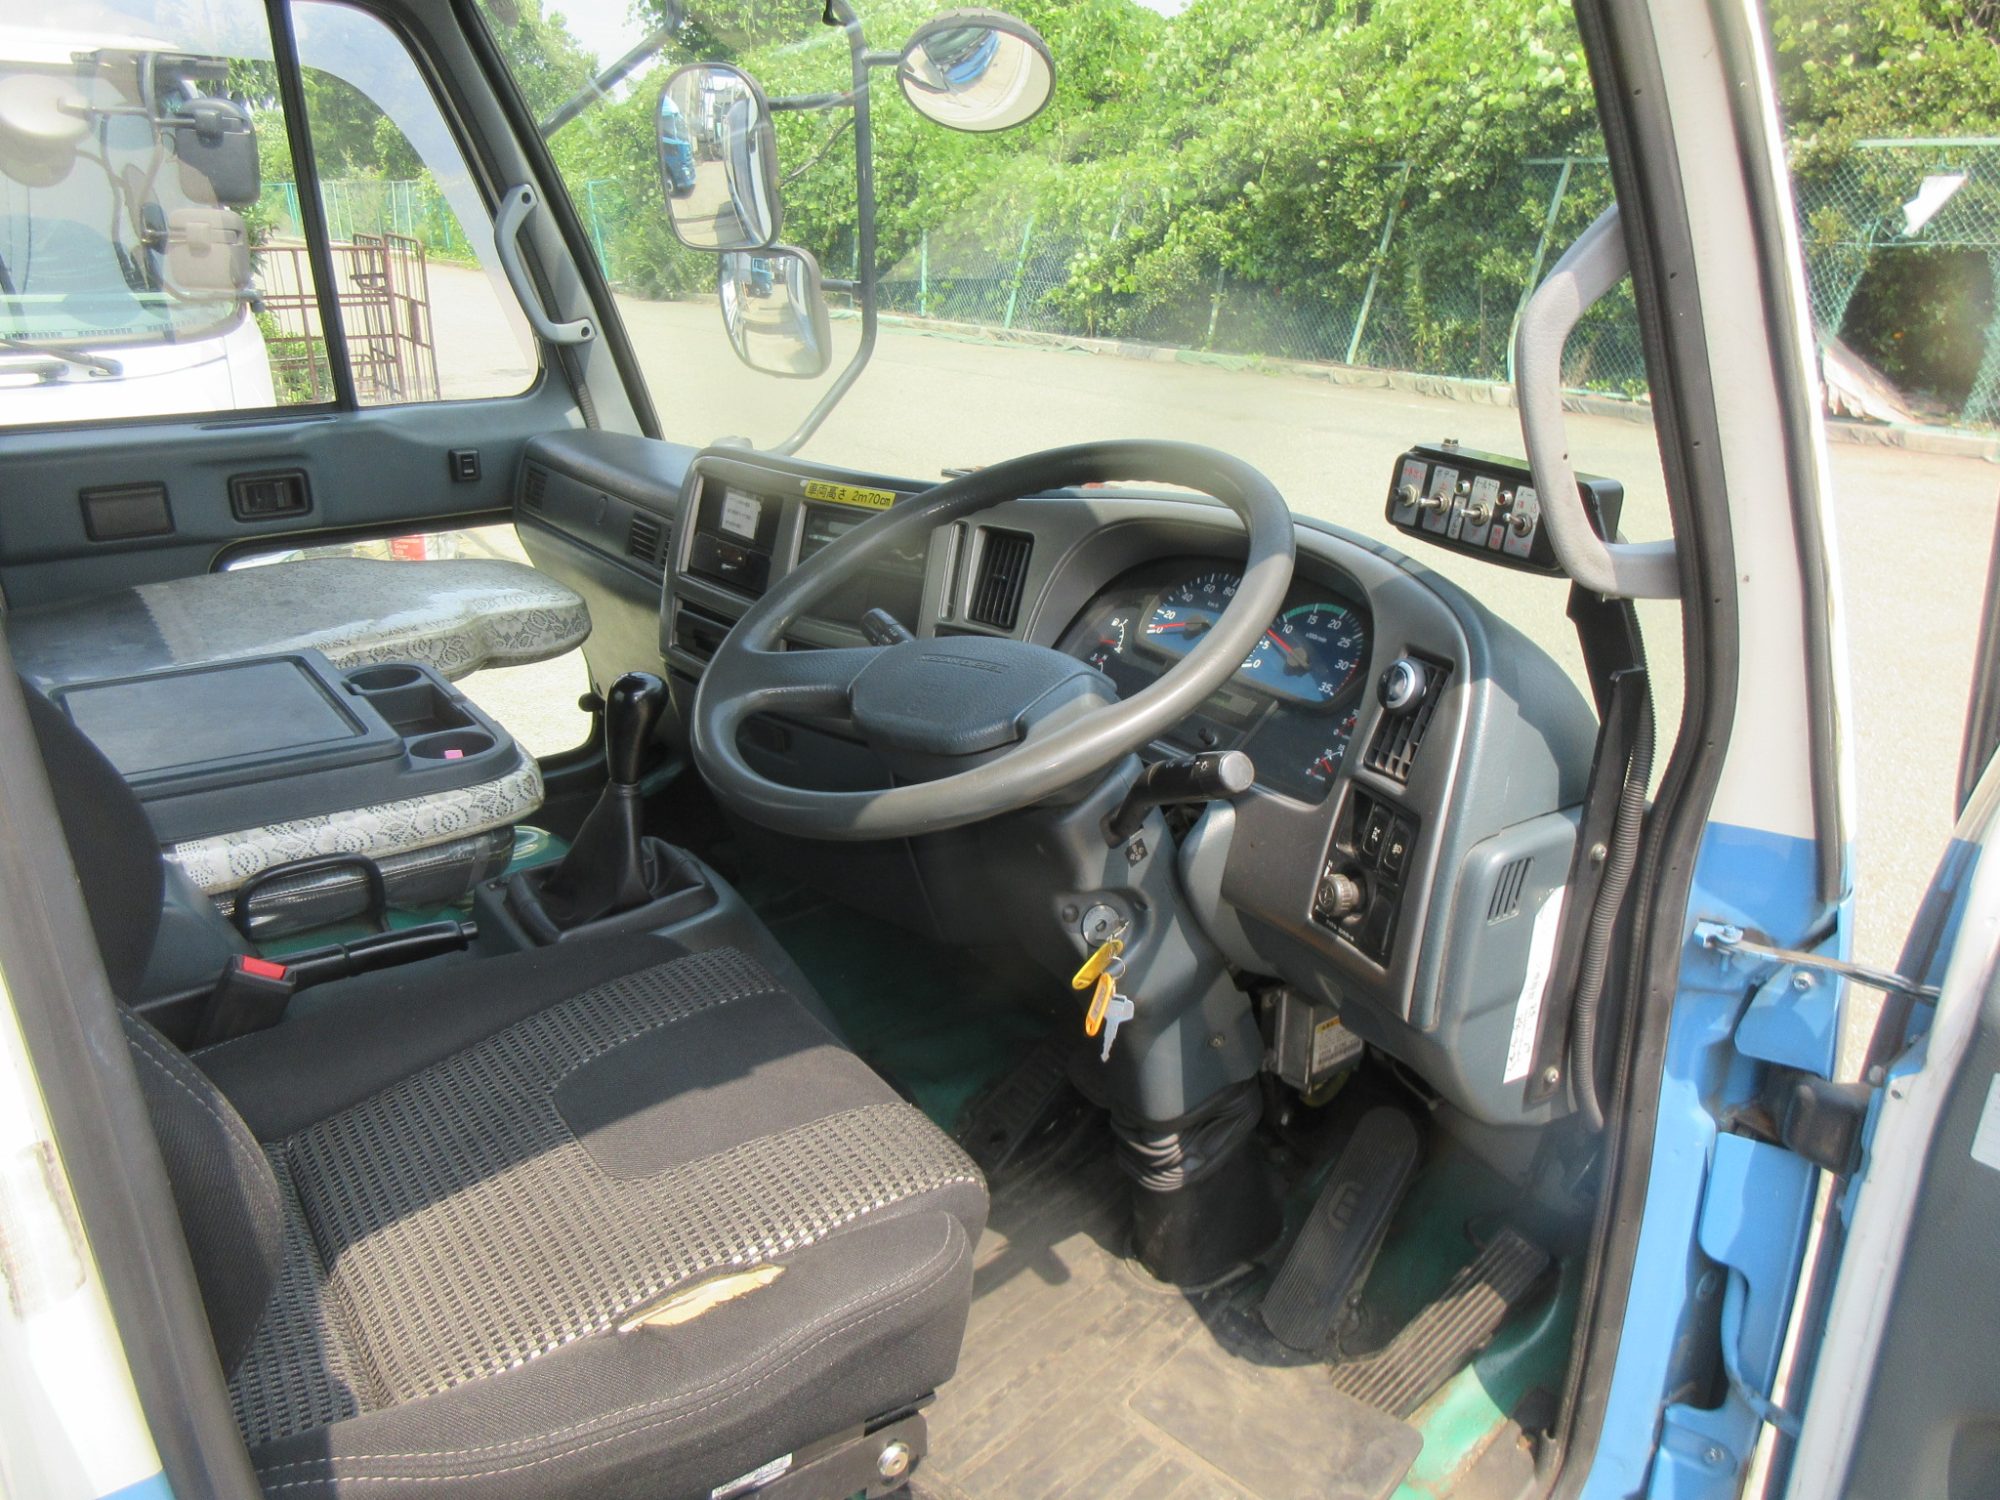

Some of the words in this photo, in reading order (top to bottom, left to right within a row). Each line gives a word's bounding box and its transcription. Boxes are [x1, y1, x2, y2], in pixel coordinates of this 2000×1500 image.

[808, 482, 847, 500] 車両高さ
[1203, 583, 1216, 594] 60
[1223, 586, 1236, 597] 80
[1181, 592, 1194, 602] 40
[1163, 610, 1176, 620] 20
[1307, 615, 1318, 625] 15
[1282, 624, 1293, 634] 10
[1327, 619, 1342, 630] 20
[1261, 640, 1270, 650] 5
[1337, 637, 1352, 648] 25
[1252, 659, 1261, 669] 0
[1334, 659, 1349, 670] 30
[1318, 681, 1333, 693] 35
